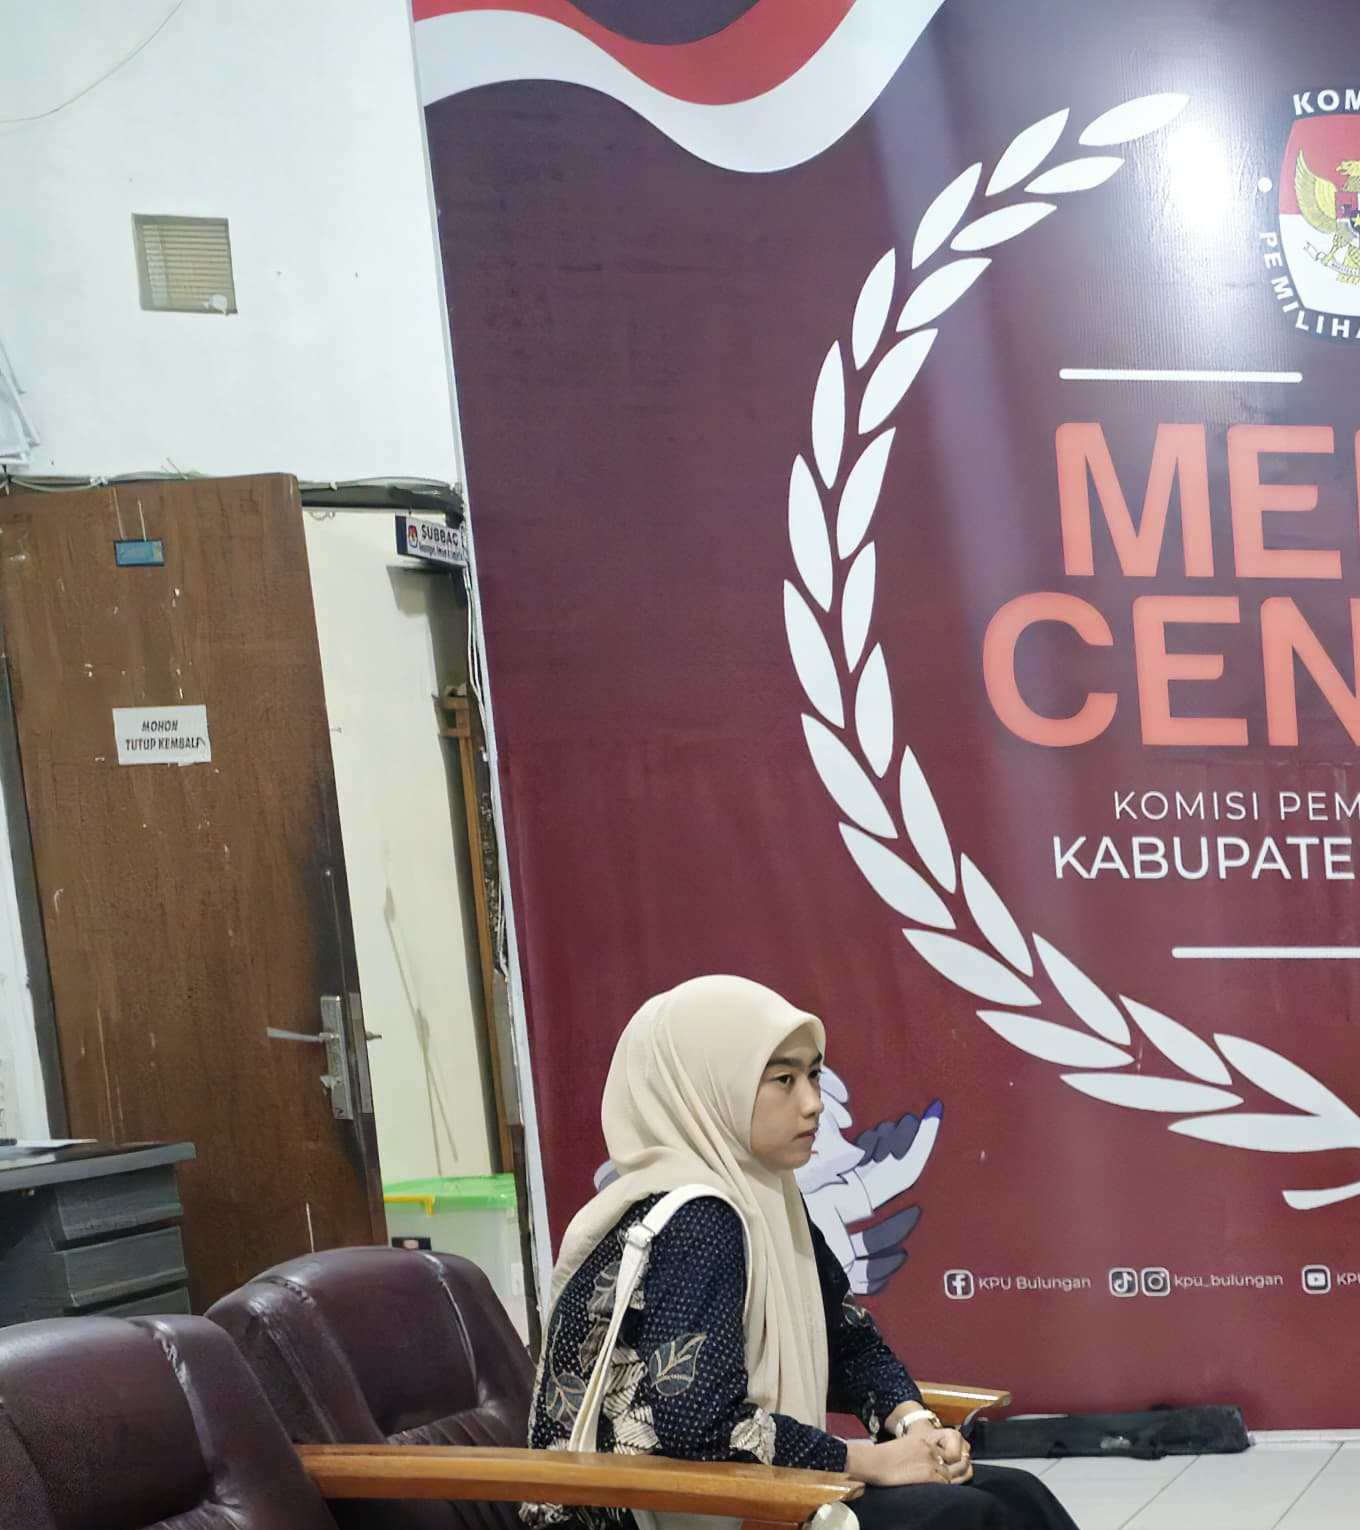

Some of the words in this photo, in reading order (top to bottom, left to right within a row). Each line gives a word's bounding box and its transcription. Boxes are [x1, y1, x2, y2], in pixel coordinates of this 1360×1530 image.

[141, 719, 178, 732] MOHON
[126, 737, 156, 751] TUTUP
[158, 736, 200, 750] KEMBALI
[1113, 790, 1261, 822] KOMISI
[978, 1276, 1012, 1290] KPU
[1016, 1275, 1092, 1293] Bulungan
[1173, 1272, 1284, 1290] kpu_bulungan
